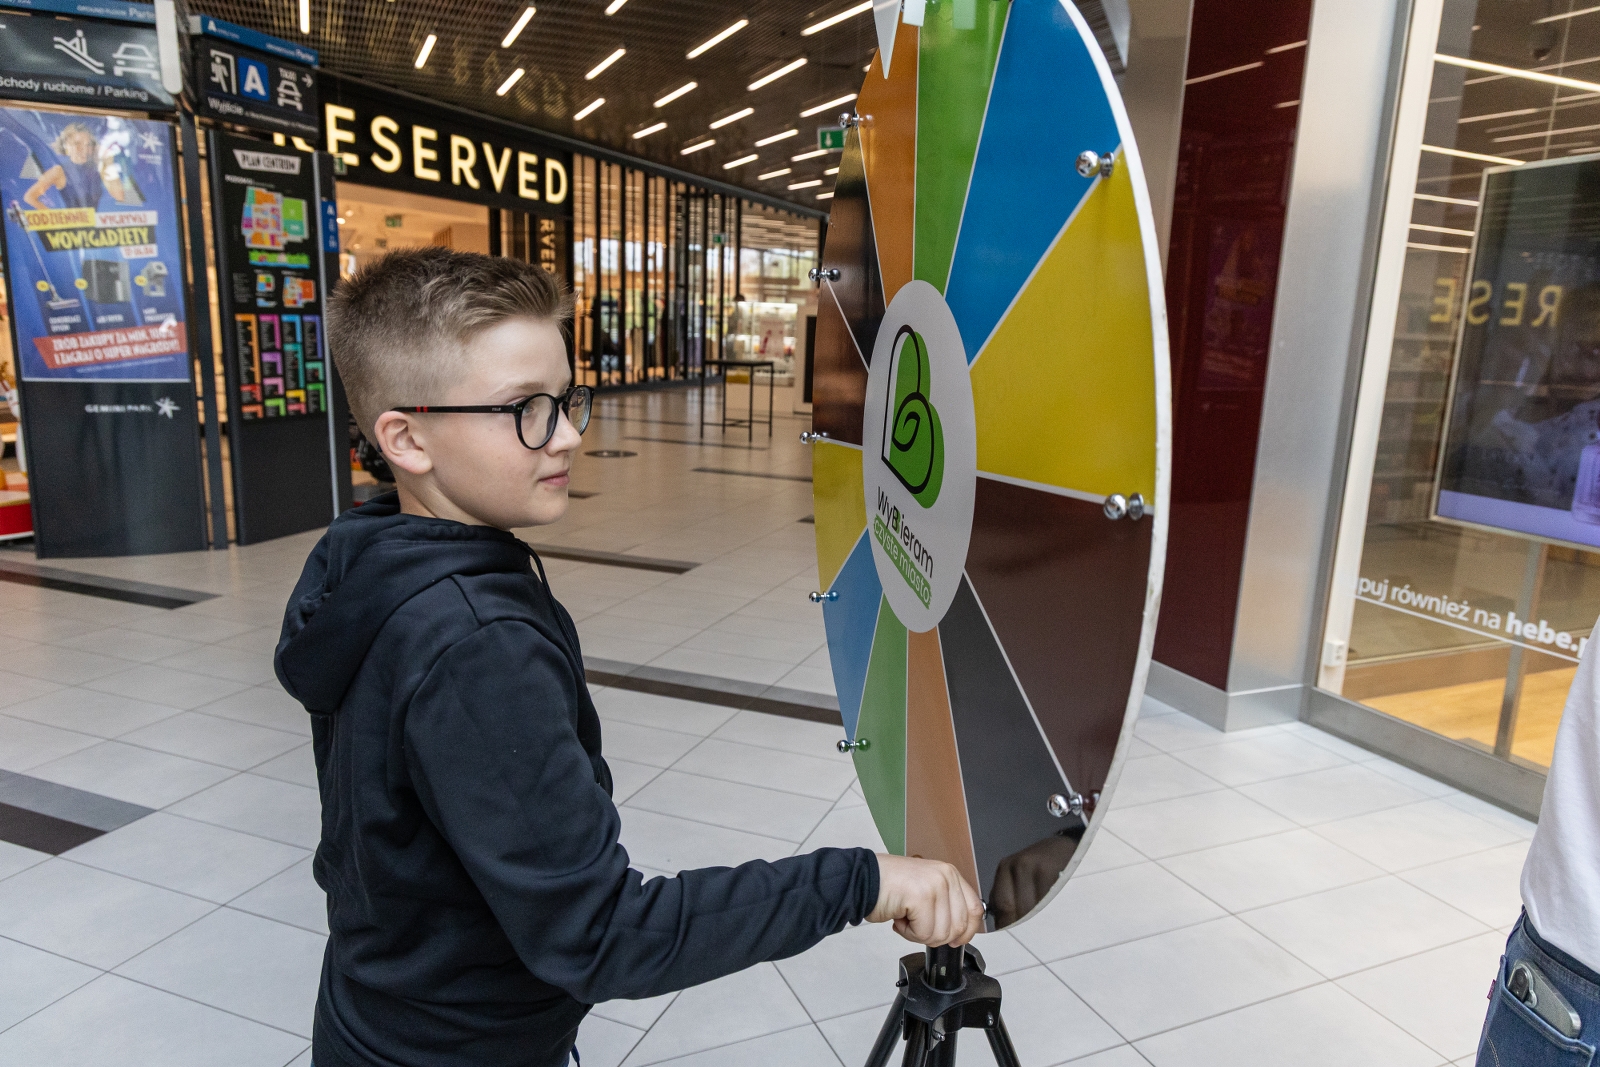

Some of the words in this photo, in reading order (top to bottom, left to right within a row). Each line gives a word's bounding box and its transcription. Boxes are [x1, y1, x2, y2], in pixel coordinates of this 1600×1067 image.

[0, 76, 40, 92] Schody
[43, 81, 94, 95] ruchome
[104, 86, 149, 102] Parking
[244, 65, 266, 96] A
[241, 154, 260, 167] PLAN
[273, 103, 568, 205] ESERVED
[899, 552, 930, 604] miasto
[1391, 584, 1469, 622] również
[1474, 609, 1501, 630] na
